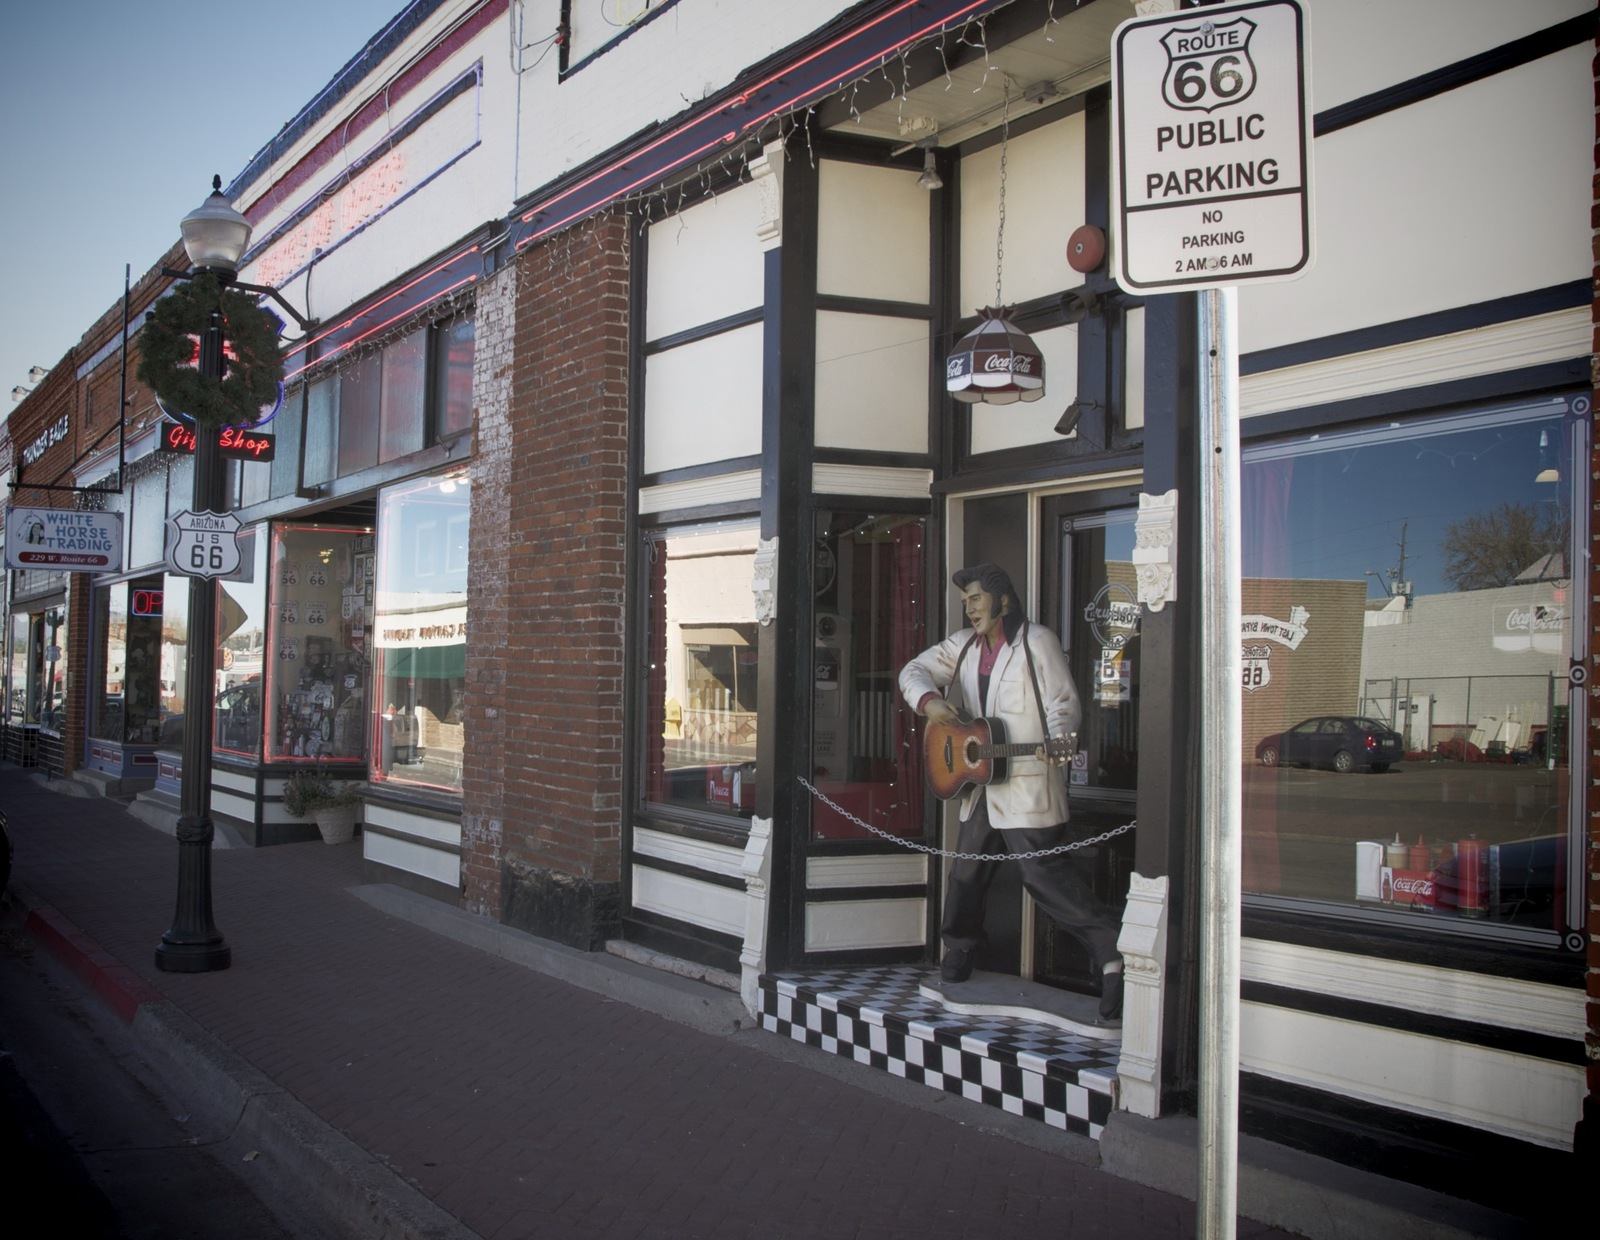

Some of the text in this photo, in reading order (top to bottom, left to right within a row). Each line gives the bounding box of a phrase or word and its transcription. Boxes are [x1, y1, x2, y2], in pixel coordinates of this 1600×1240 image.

[1177, 30, 1239, 52] ROUTE
[1173, 55, 1243, 103] 66
[1157, 114, 1265, 152] PUBLIC
[1146, 159, 1279, 198] PARKING
[1202, 210, 1223, 224] NO
[1182, 230, 1245, 249] PARKING
[1175, 260, 1183, 272] 2
[1231, 253, 1253, 267] AM
[169, 425, 270, 455] Gif Shop
[46, 513, 94, 527] WHITE
[190, 518, 226, 530] ARIZONA
[56, 525, 108, 539] HORSE
[47, 537, 113, 551] TRADING
[191, 544, 223, 570] 66
[134, 591, 163, 613] OP
